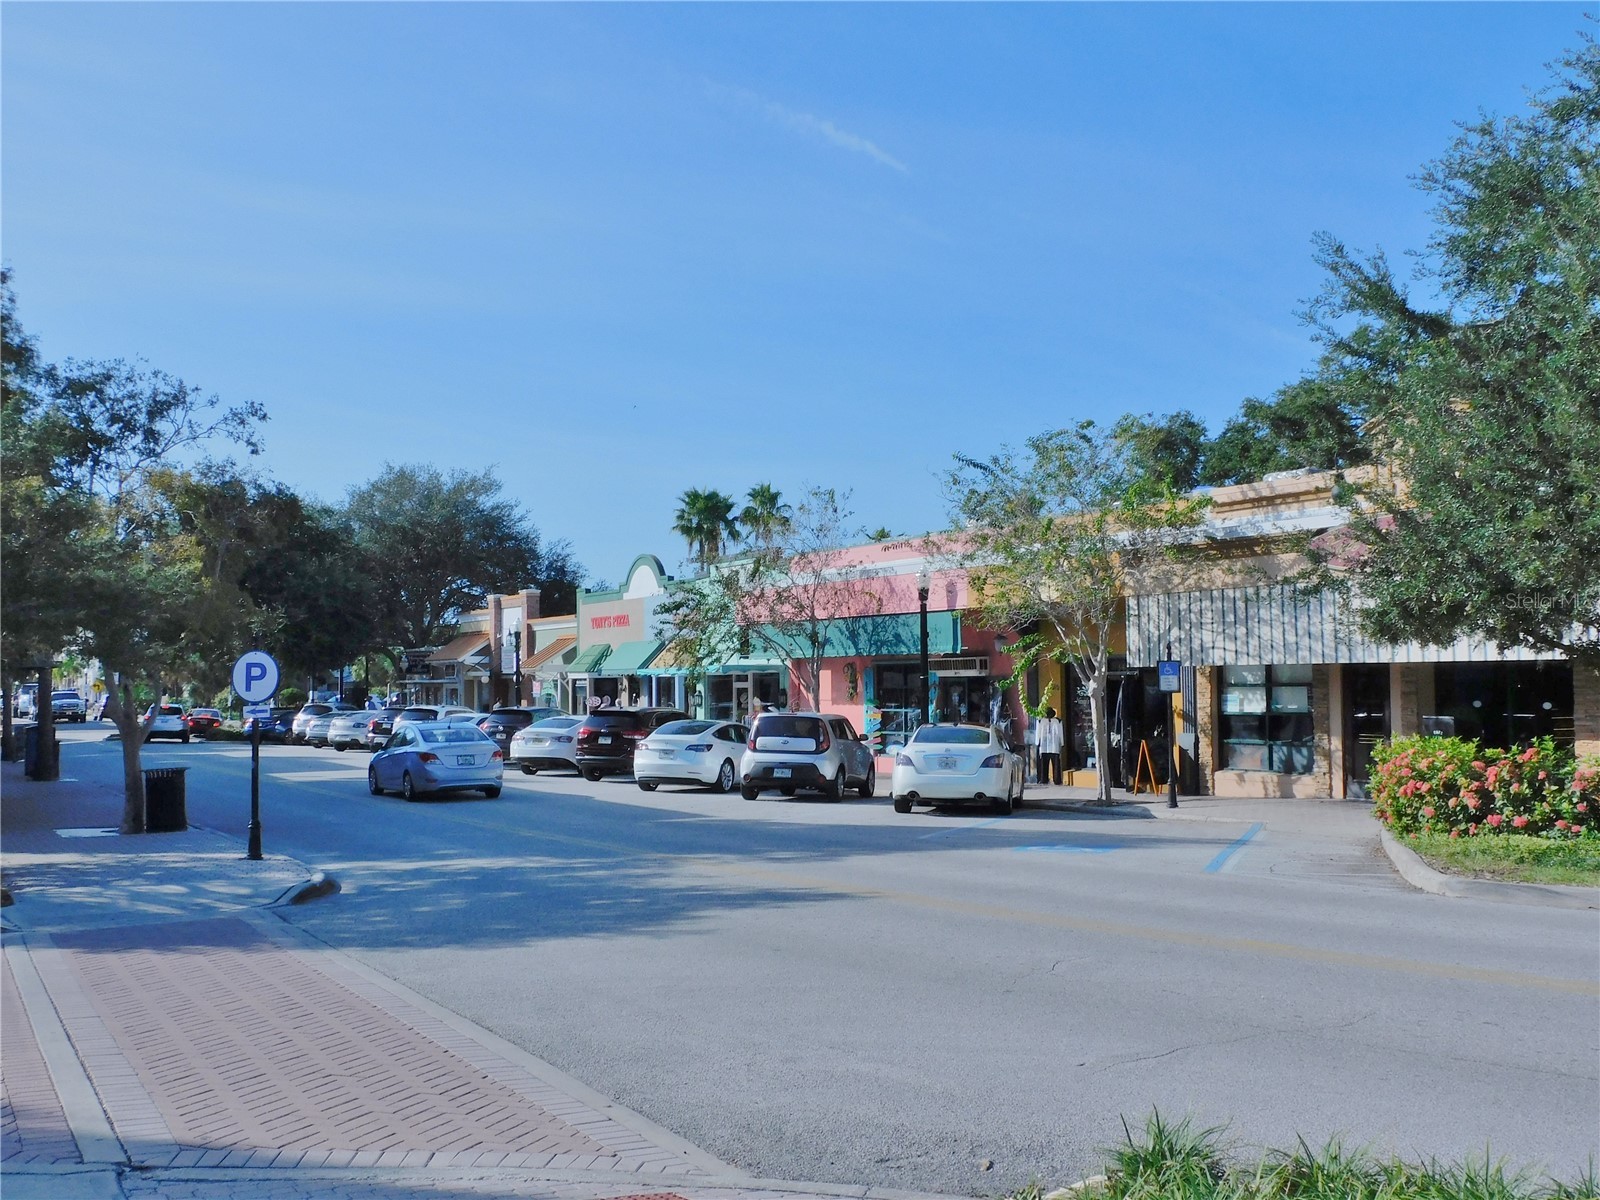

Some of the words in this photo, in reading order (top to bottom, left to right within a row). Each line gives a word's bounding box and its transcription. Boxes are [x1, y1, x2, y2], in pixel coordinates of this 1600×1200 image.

[591, 616, 612, 629] TONY'S
[612, 614, 630, 627] PIZZA
[245, 662, 267, 692] P
